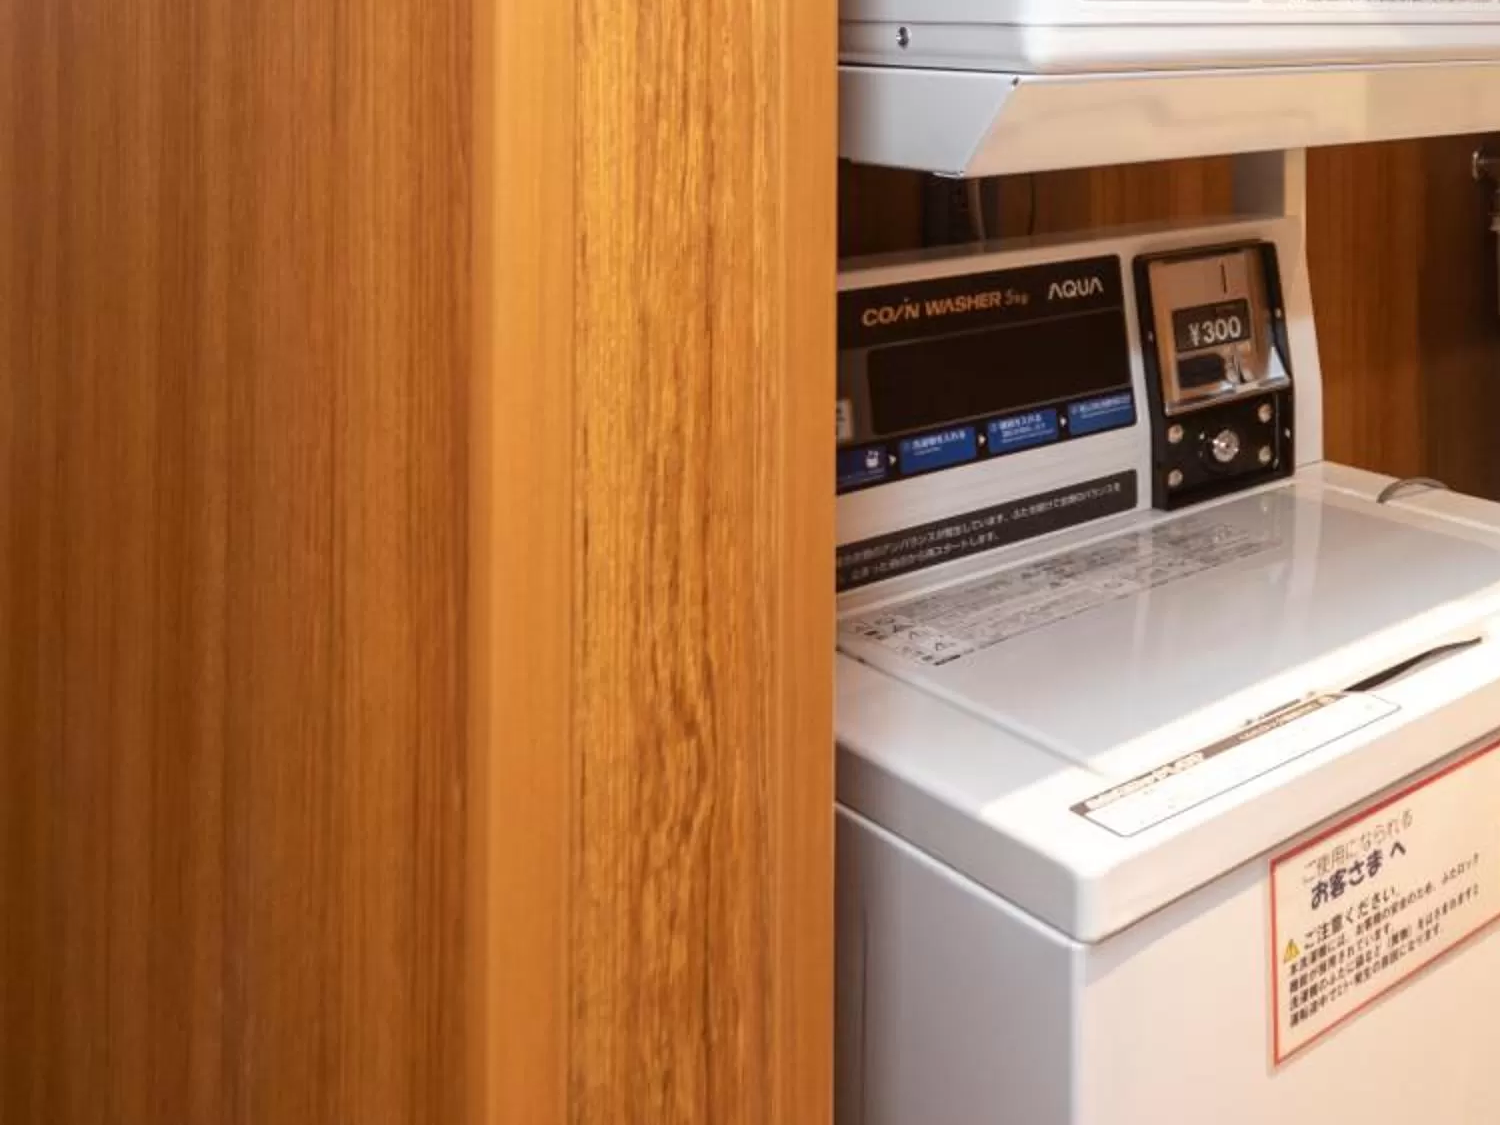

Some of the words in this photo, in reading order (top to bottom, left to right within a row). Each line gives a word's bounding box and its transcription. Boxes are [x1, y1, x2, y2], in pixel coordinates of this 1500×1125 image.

[925, 292, 1001, 316] WASHER
[1048, 277, 1104, 300] AQUA
[1188, 315, 1242, 348] ¥300
[1311, 841, 1406, 910] お客さまへ
